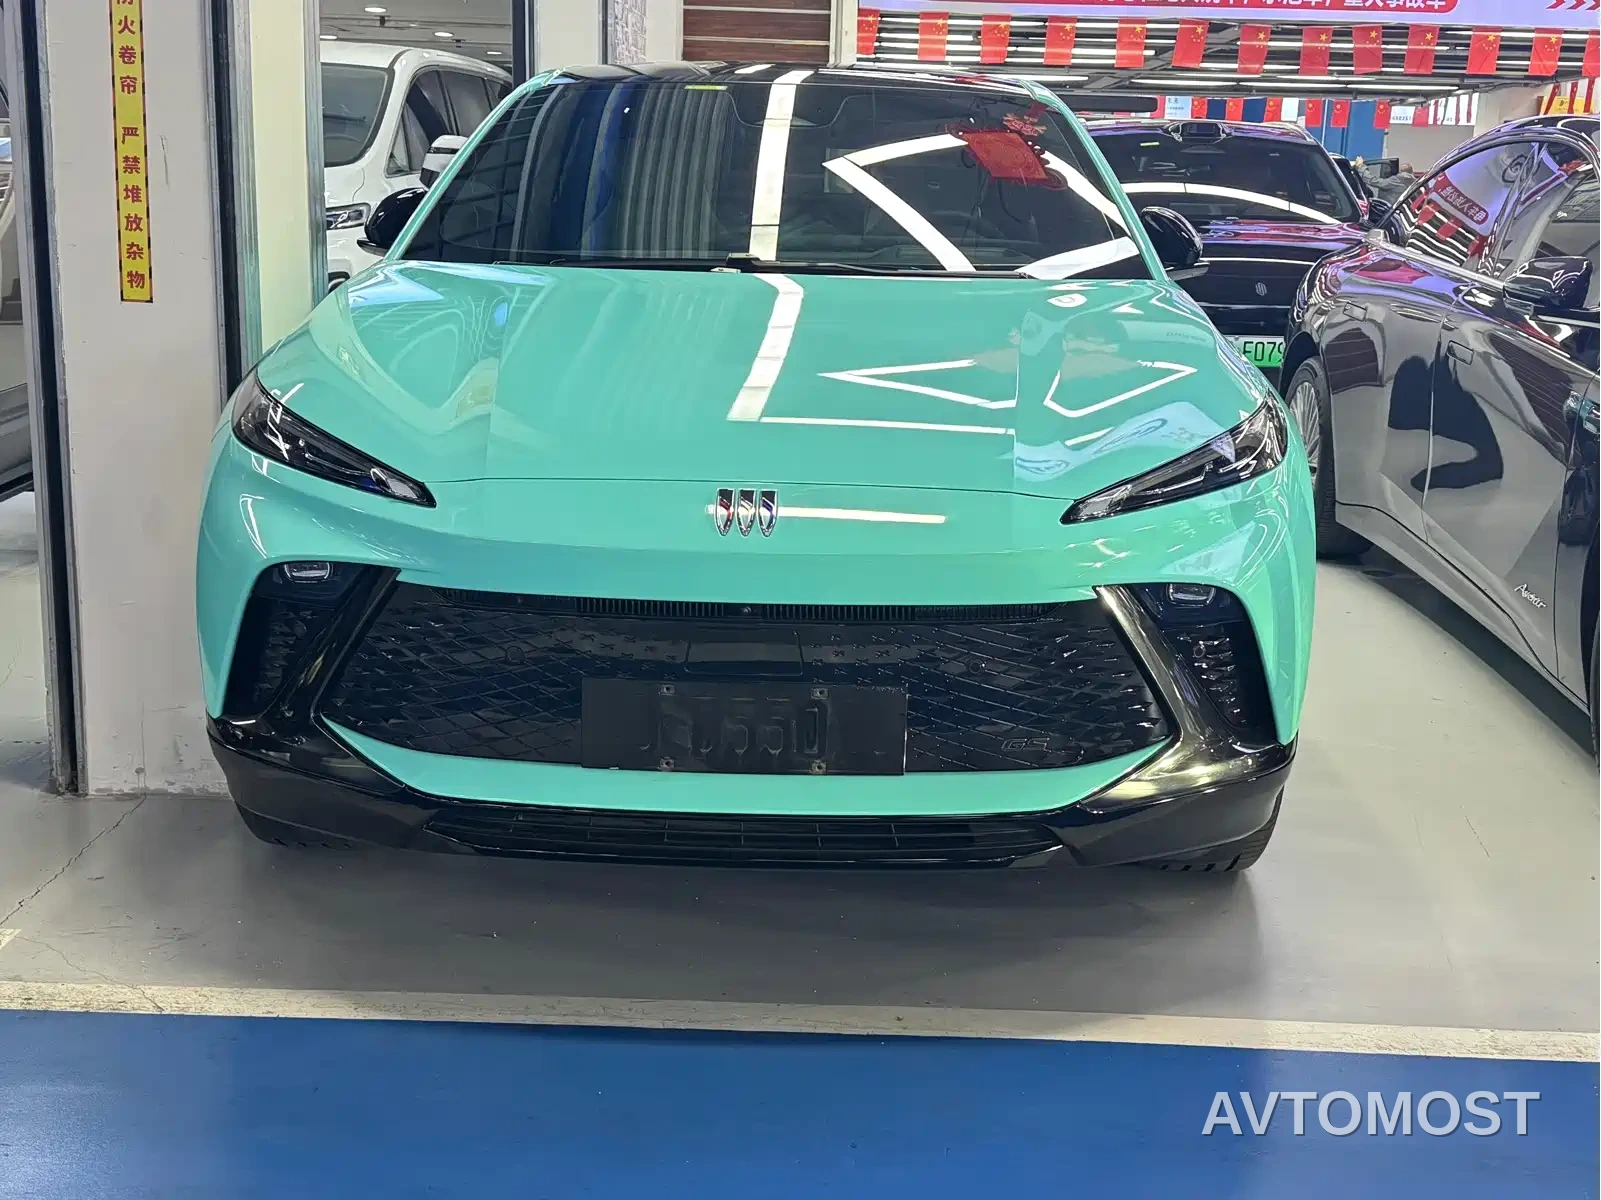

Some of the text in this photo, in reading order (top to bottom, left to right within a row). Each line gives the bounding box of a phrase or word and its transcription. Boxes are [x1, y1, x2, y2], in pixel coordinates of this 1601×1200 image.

[116, 0, 146, 290] 火卷帘 严禁堆放杂物
